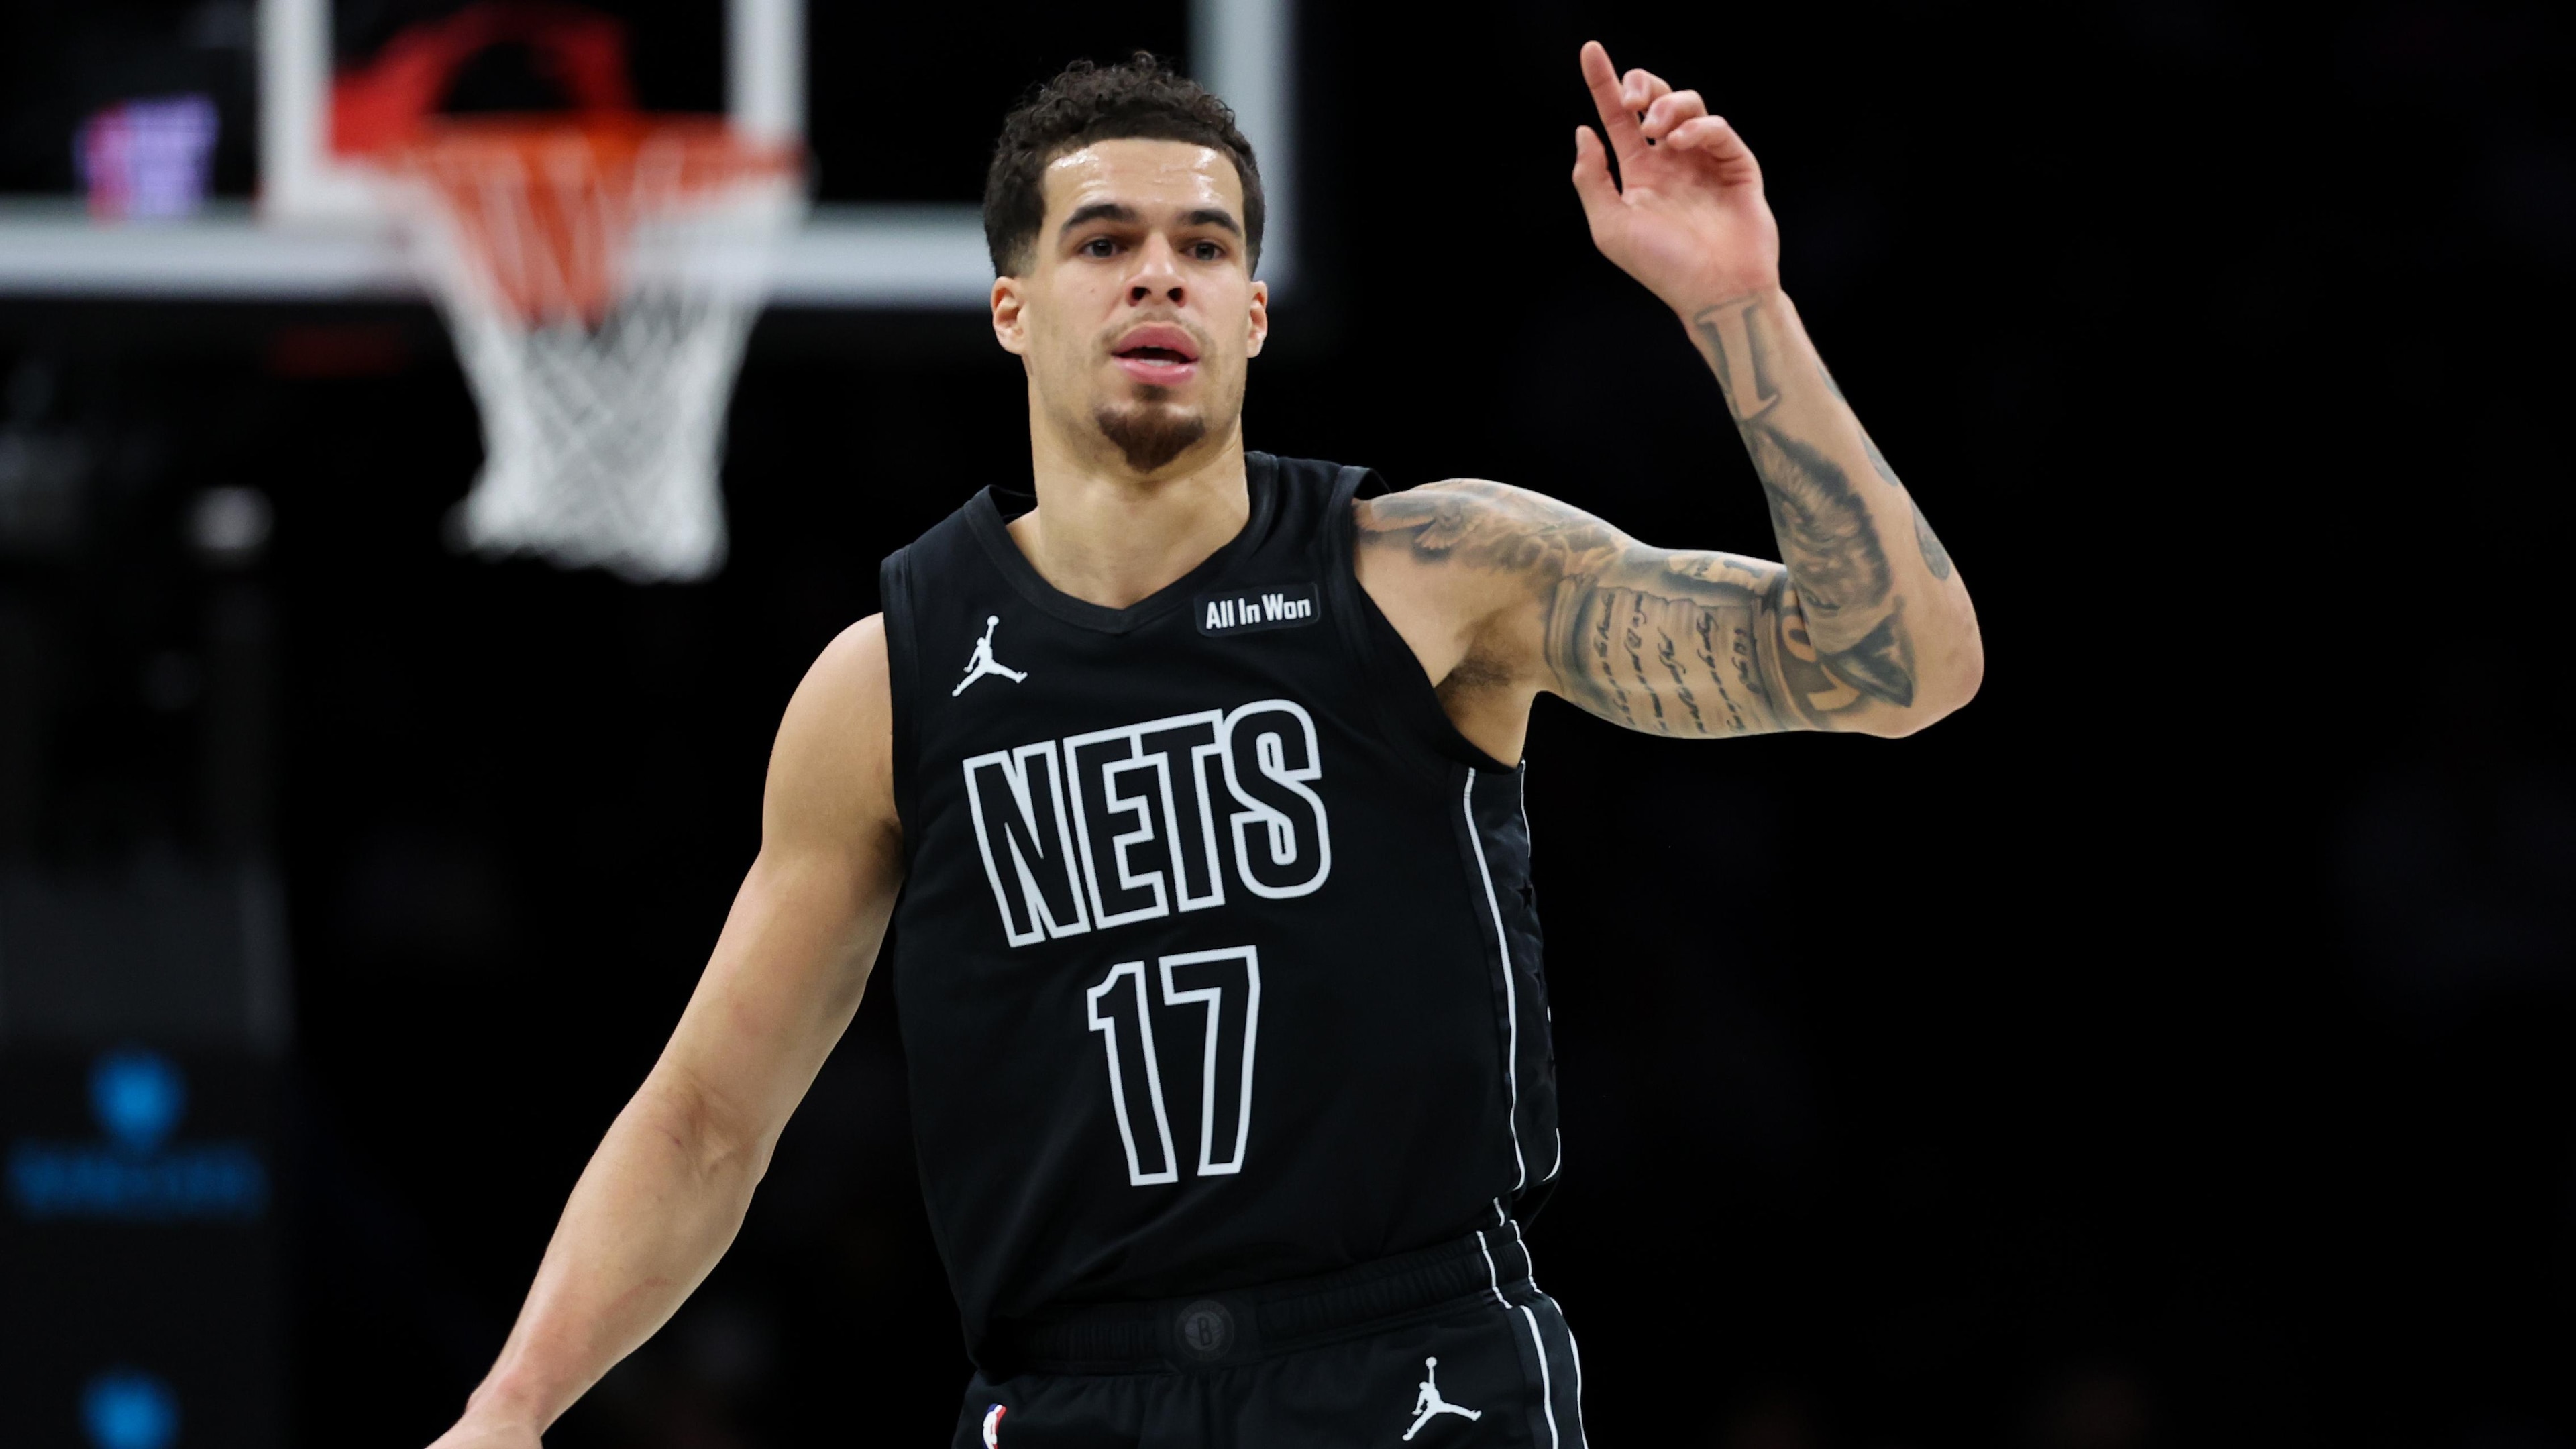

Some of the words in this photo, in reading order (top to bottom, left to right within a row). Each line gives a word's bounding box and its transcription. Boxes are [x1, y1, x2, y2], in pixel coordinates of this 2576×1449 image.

[1206, 601, 1235, 629] All
[1238, 598, 1261, 625] In
[1261, 593, 1311, 621] Won
[963, 698, 1332, 948] NETS
[1087, 945, 1261, 1186] 17
